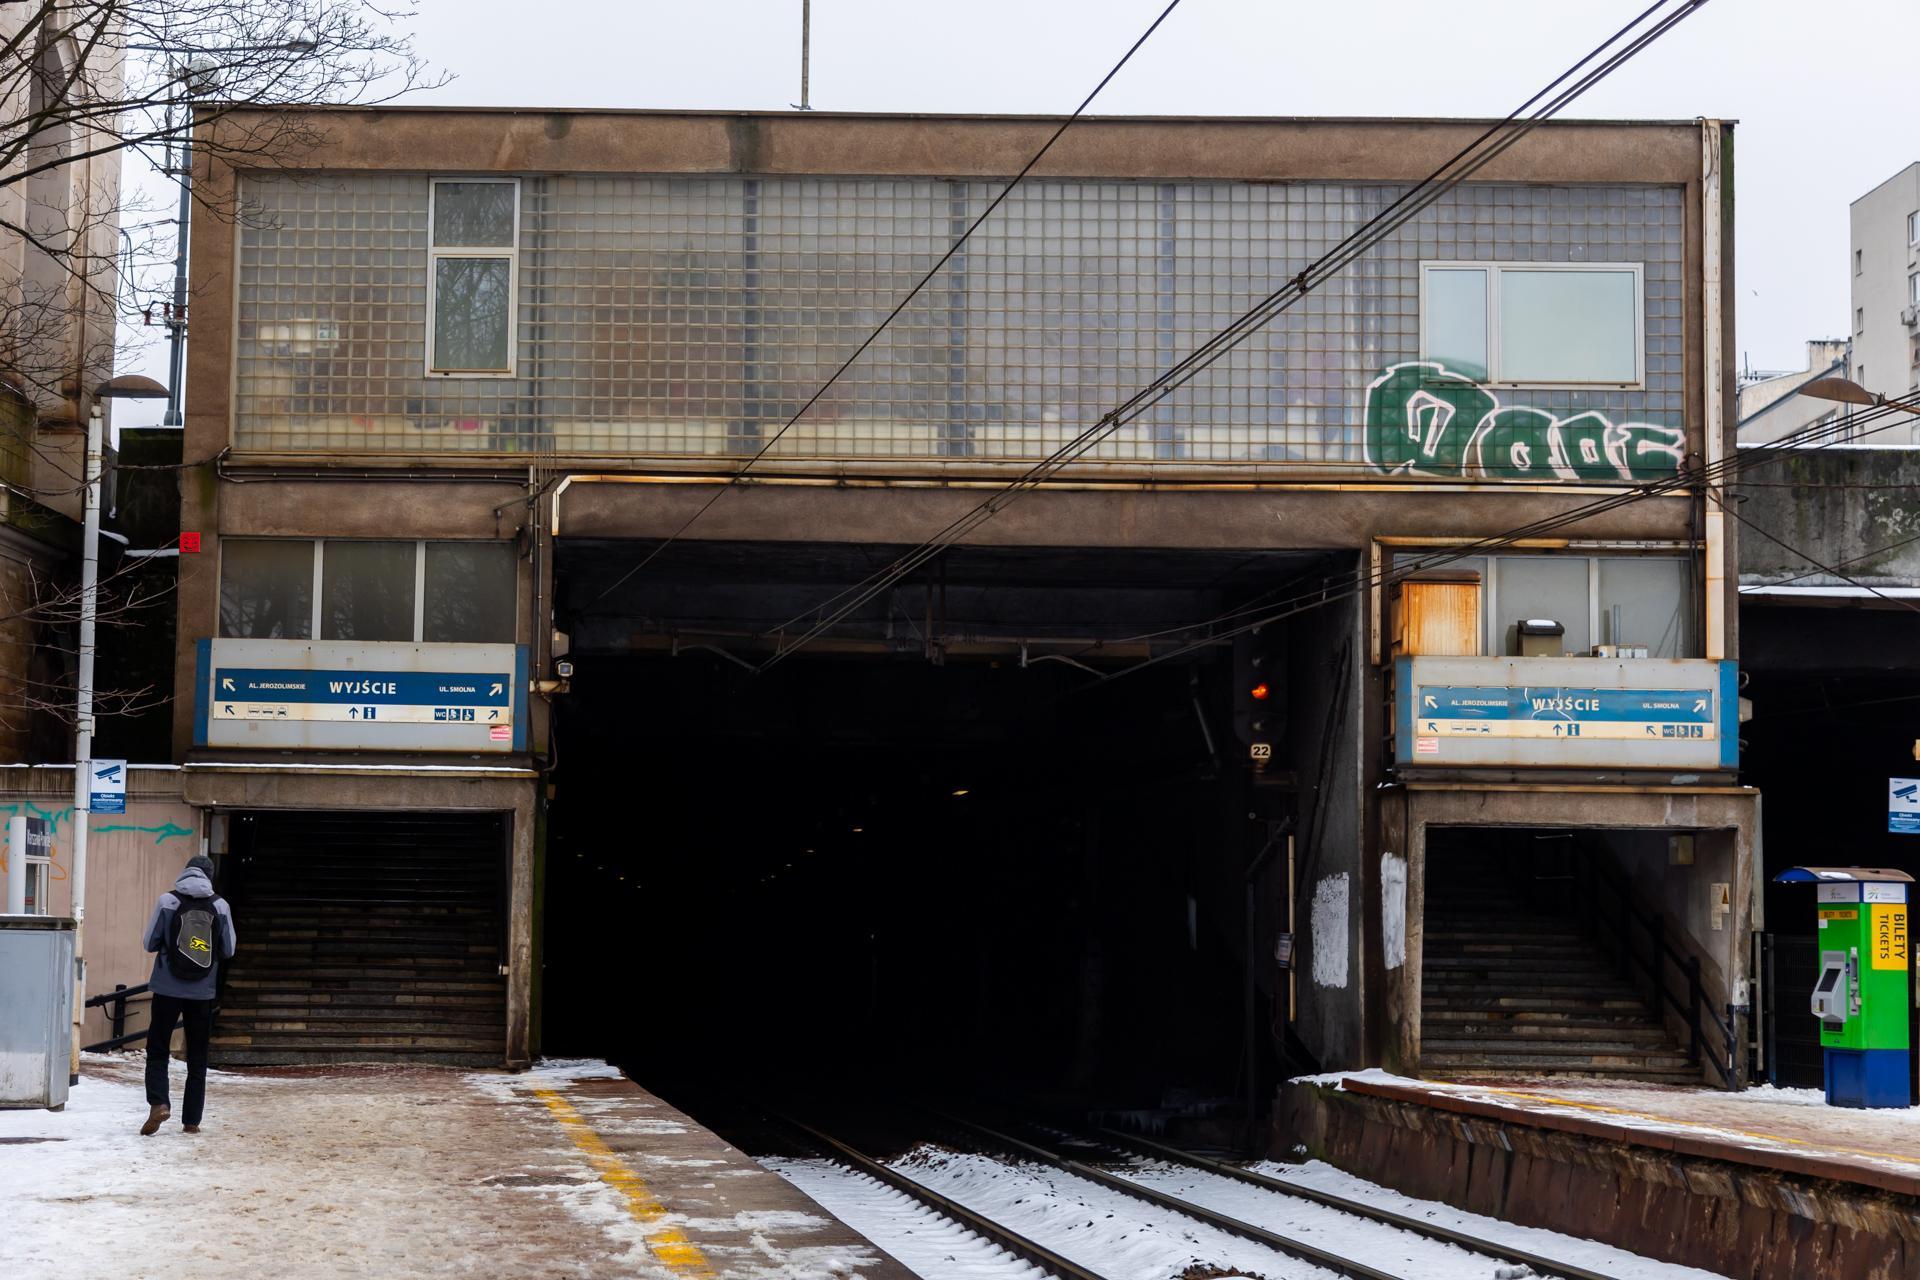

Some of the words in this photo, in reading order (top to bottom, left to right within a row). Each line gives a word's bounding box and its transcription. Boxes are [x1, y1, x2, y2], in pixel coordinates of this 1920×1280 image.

[259, 682, 306, 690] JEROZOLIMSKIE
[329, 679, 397, 695] WYJŚCIE
[1461, 699, 1509, 707] JEROZOLIMSKIE
[1532, 696, 1600, 711] WYJŚCIE
[1253, 746, 1269, 756] 22
[1879, 914, 1890, 960] TICKETS
[1893, 913, 1906, 960] BILETY
